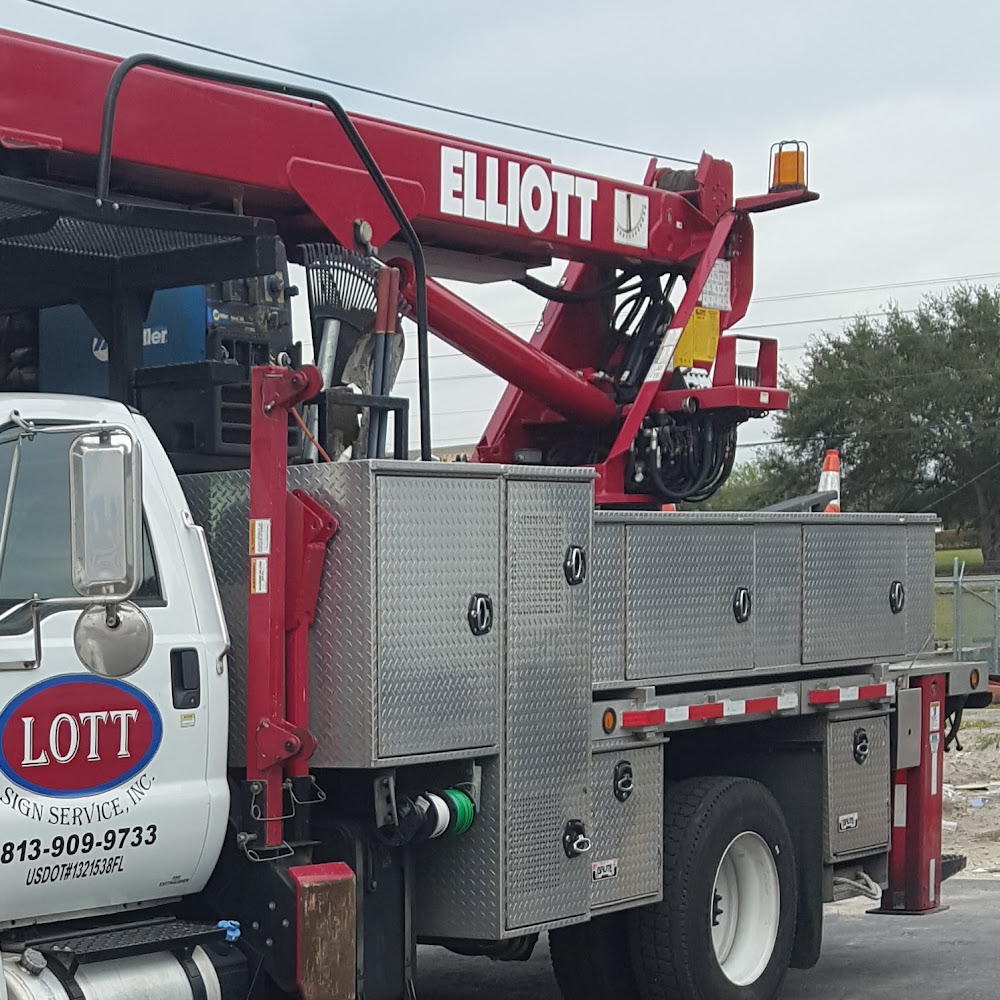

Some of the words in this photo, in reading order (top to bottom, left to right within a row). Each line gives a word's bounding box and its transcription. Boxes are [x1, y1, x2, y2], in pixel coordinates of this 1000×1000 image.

[440, 145, 598, 242] ELLIOTT
[143, 328, 168, 346] ller
[21, 709, 139, 768] LOTT
[0, 786, 44, 822] SIGN
[47, 797, 130, 827] SERVICE,
[125, 773, 156, 807] INC.
[0, 824, 158, 864] 813-909-9733
[25, 855, 124, 886] USDOT#1321538FL
